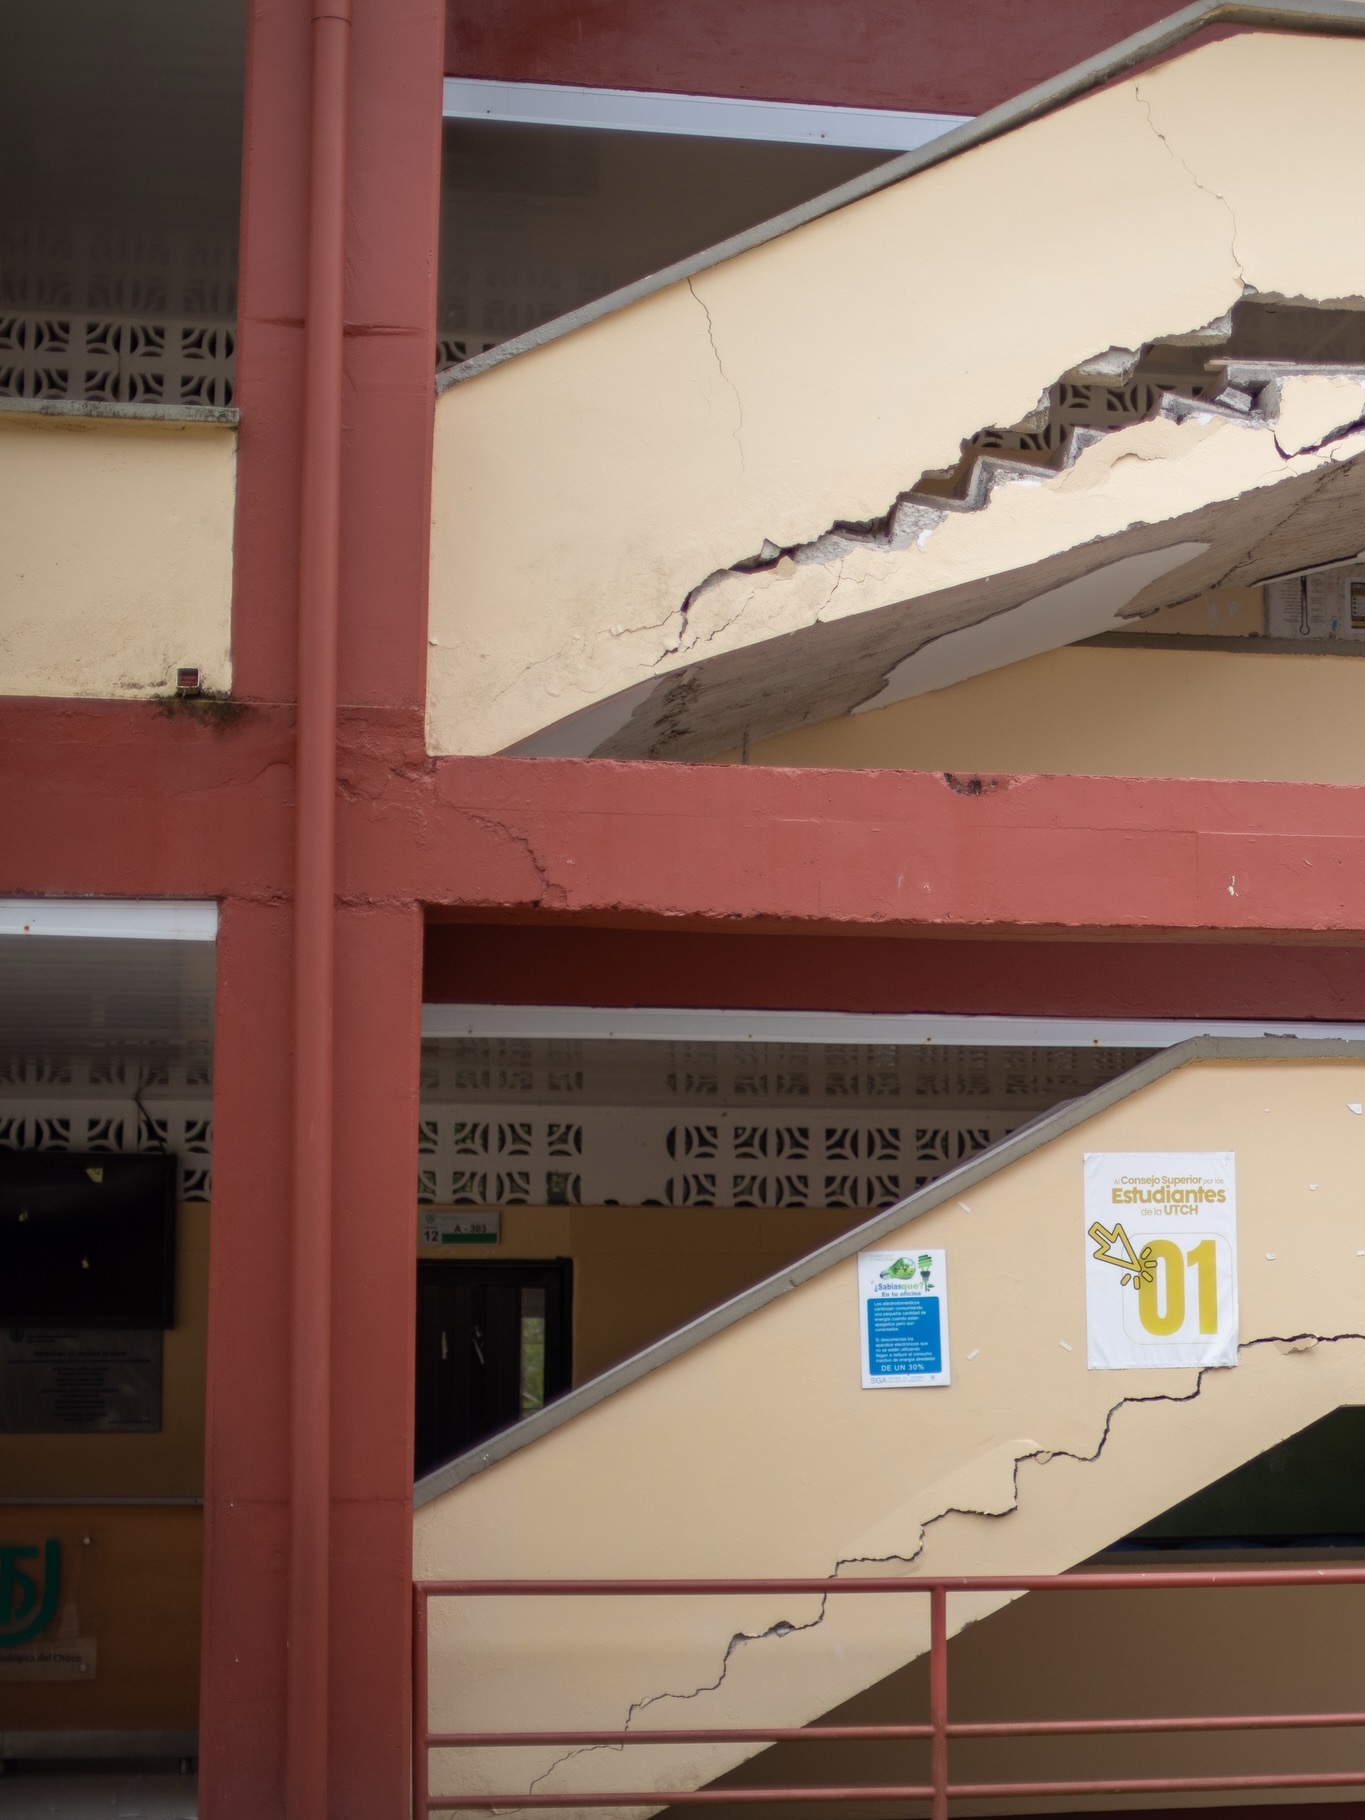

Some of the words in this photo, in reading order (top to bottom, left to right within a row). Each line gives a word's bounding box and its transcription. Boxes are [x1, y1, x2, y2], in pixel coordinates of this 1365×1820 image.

[1121, 1175, 1160, 1187] Consejo
[1161, 1175, 1202, 1187] Superior
[1111, 1185, 1226, 1204] Estudiantes
[1141, 1207, 1153, 1216] de
[1154, 1207, 1162, 1216] la
[1164, 1204, 1198, 1216] UTCH
[453, 1225, 461, 1233] A
[424, 1230, 439, 1242] 12
[1138, 1239, 1218, 1337] 01
[881, 1364, 892, 1372] DE
[870, 1377, 887, 1385] SGA
[37, 1653, 51, 1662] del
